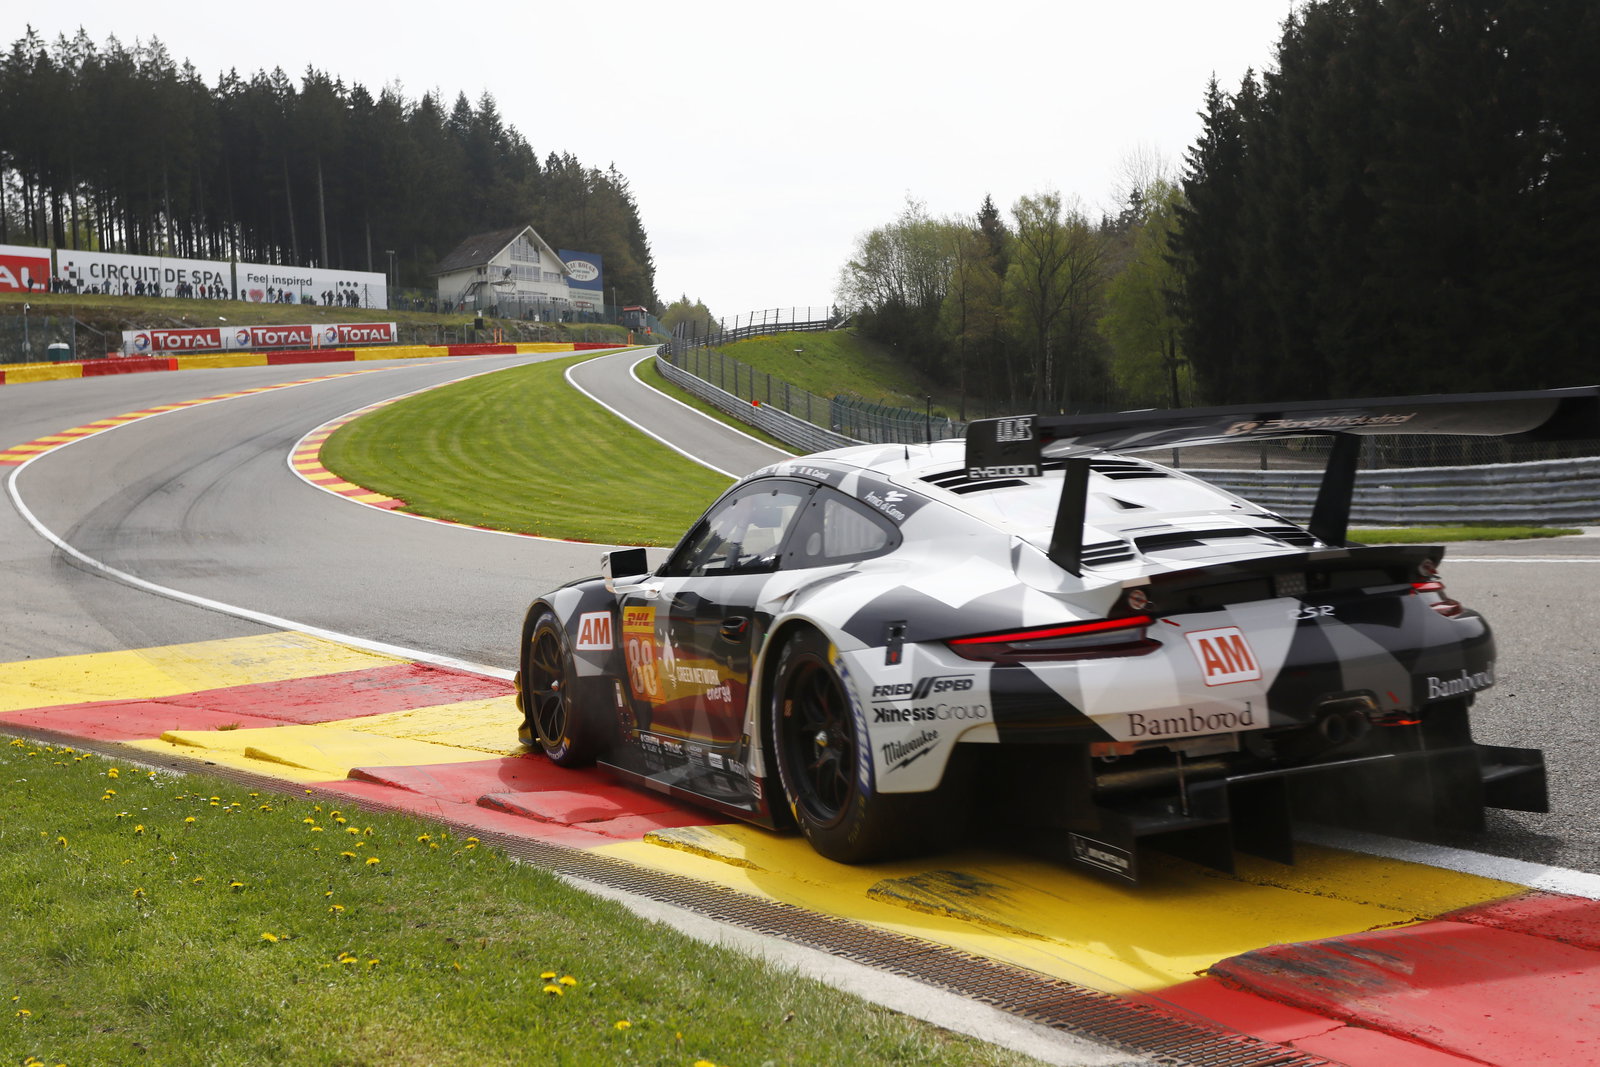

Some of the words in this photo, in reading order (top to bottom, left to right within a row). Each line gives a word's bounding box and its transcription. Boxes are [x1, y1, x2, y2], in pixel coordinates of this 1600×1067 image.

[90, 263, 159, 281] CIRCUIT
[165, 268, 187, 284] DE
[192, 270, 224, 286] SPA
[247, 273, 268, 284] Feel
[272, 275, 313, 287] inspired
[153, 332, 219, 348] TOTAL
[253, 329, 311, 344] TOTAL
[340, 326, 390, 341] TOTAL
[626, 612, 650, 626] DHL
[1288, 605, 1336, 620] RSR
[579, 617, 610, 645] AM
[1197, 634, 1256, 678] AM
[628, 638, 657, 697] 88
[706, 685, 732, 703] energy
[872, 683, 914, 698] FRIED
[933, 678, 974, 693] SPED
[1128, 702, 1256, 737] Bambood
[881, 729, 940, 766] Milwaukee
